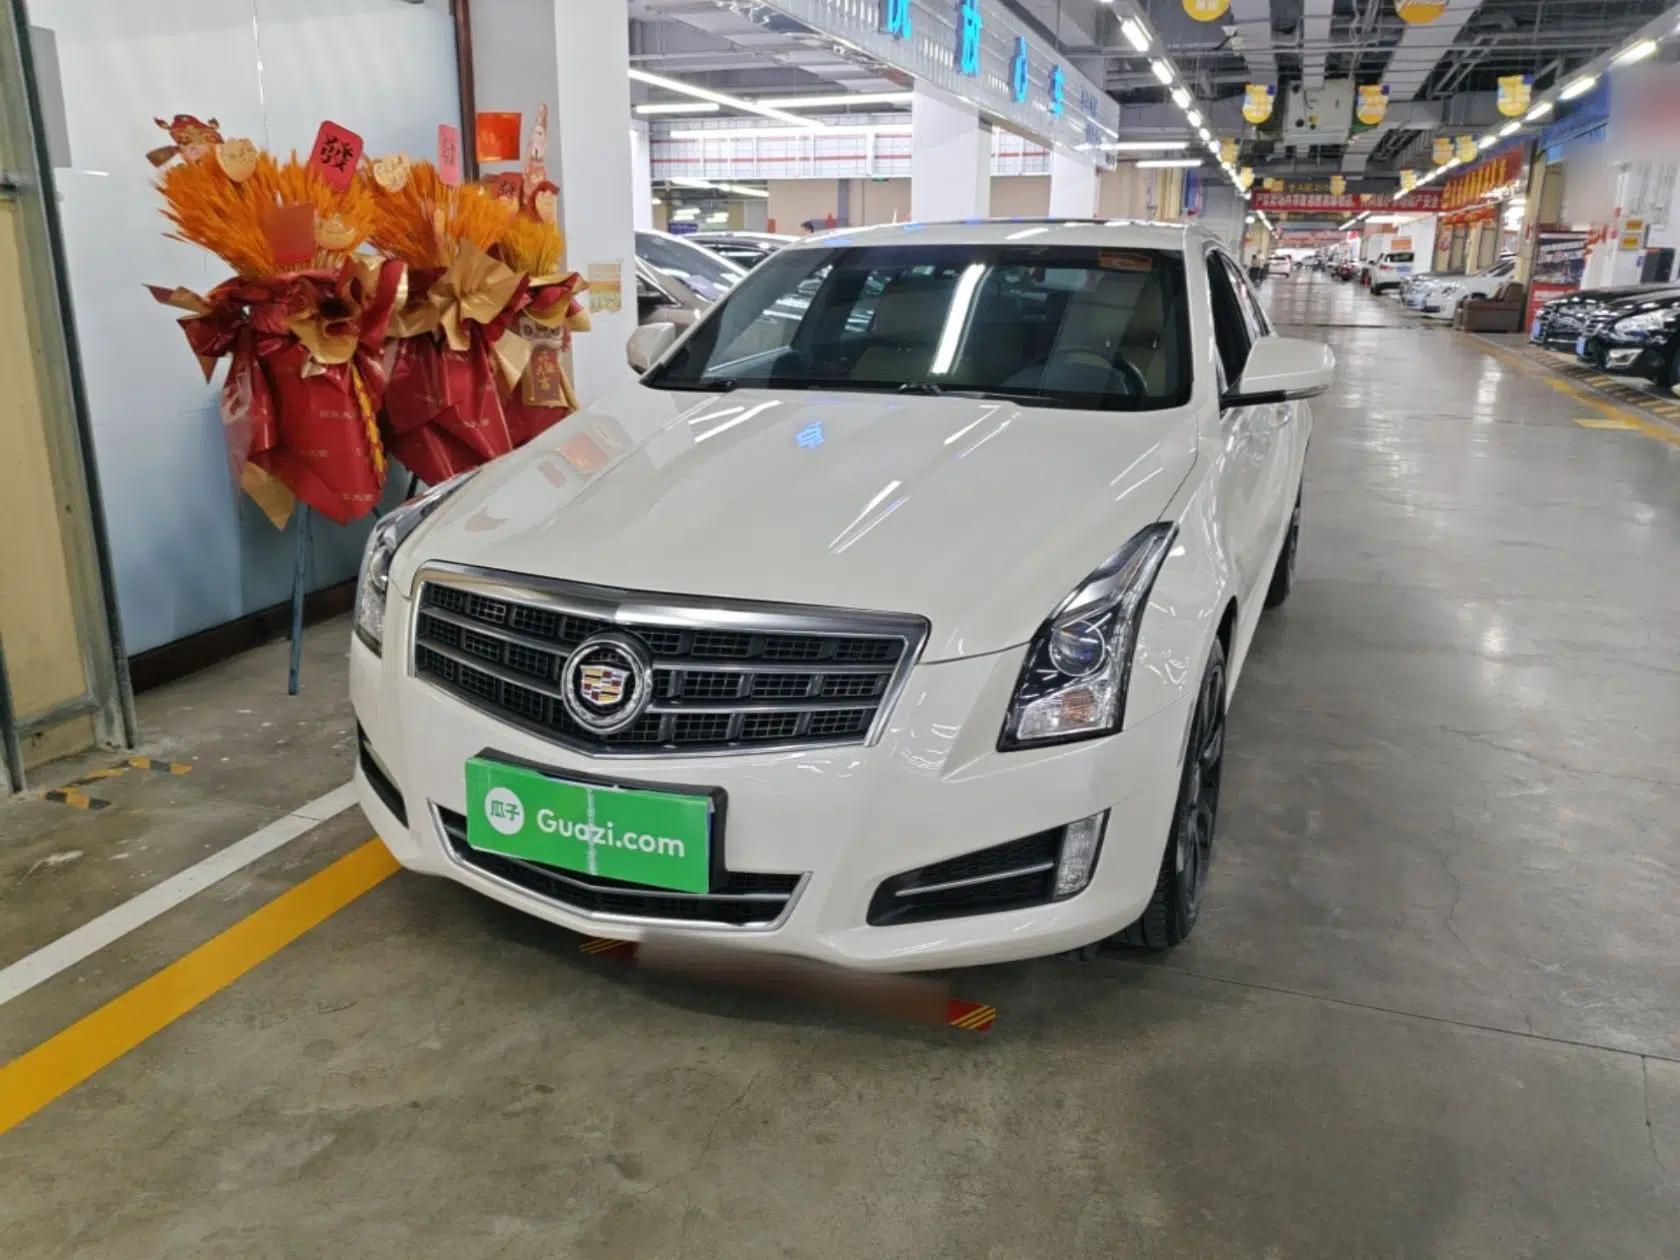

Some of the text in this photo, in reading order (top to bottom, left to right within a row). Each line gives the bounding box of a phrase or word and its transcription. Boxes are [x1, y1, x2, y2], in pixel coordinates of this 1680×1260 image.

[320, 134, 354, 172] 發
[490, 799, 521, 822] 瓜子
[536, 808, 685, 858] Guazi.com
